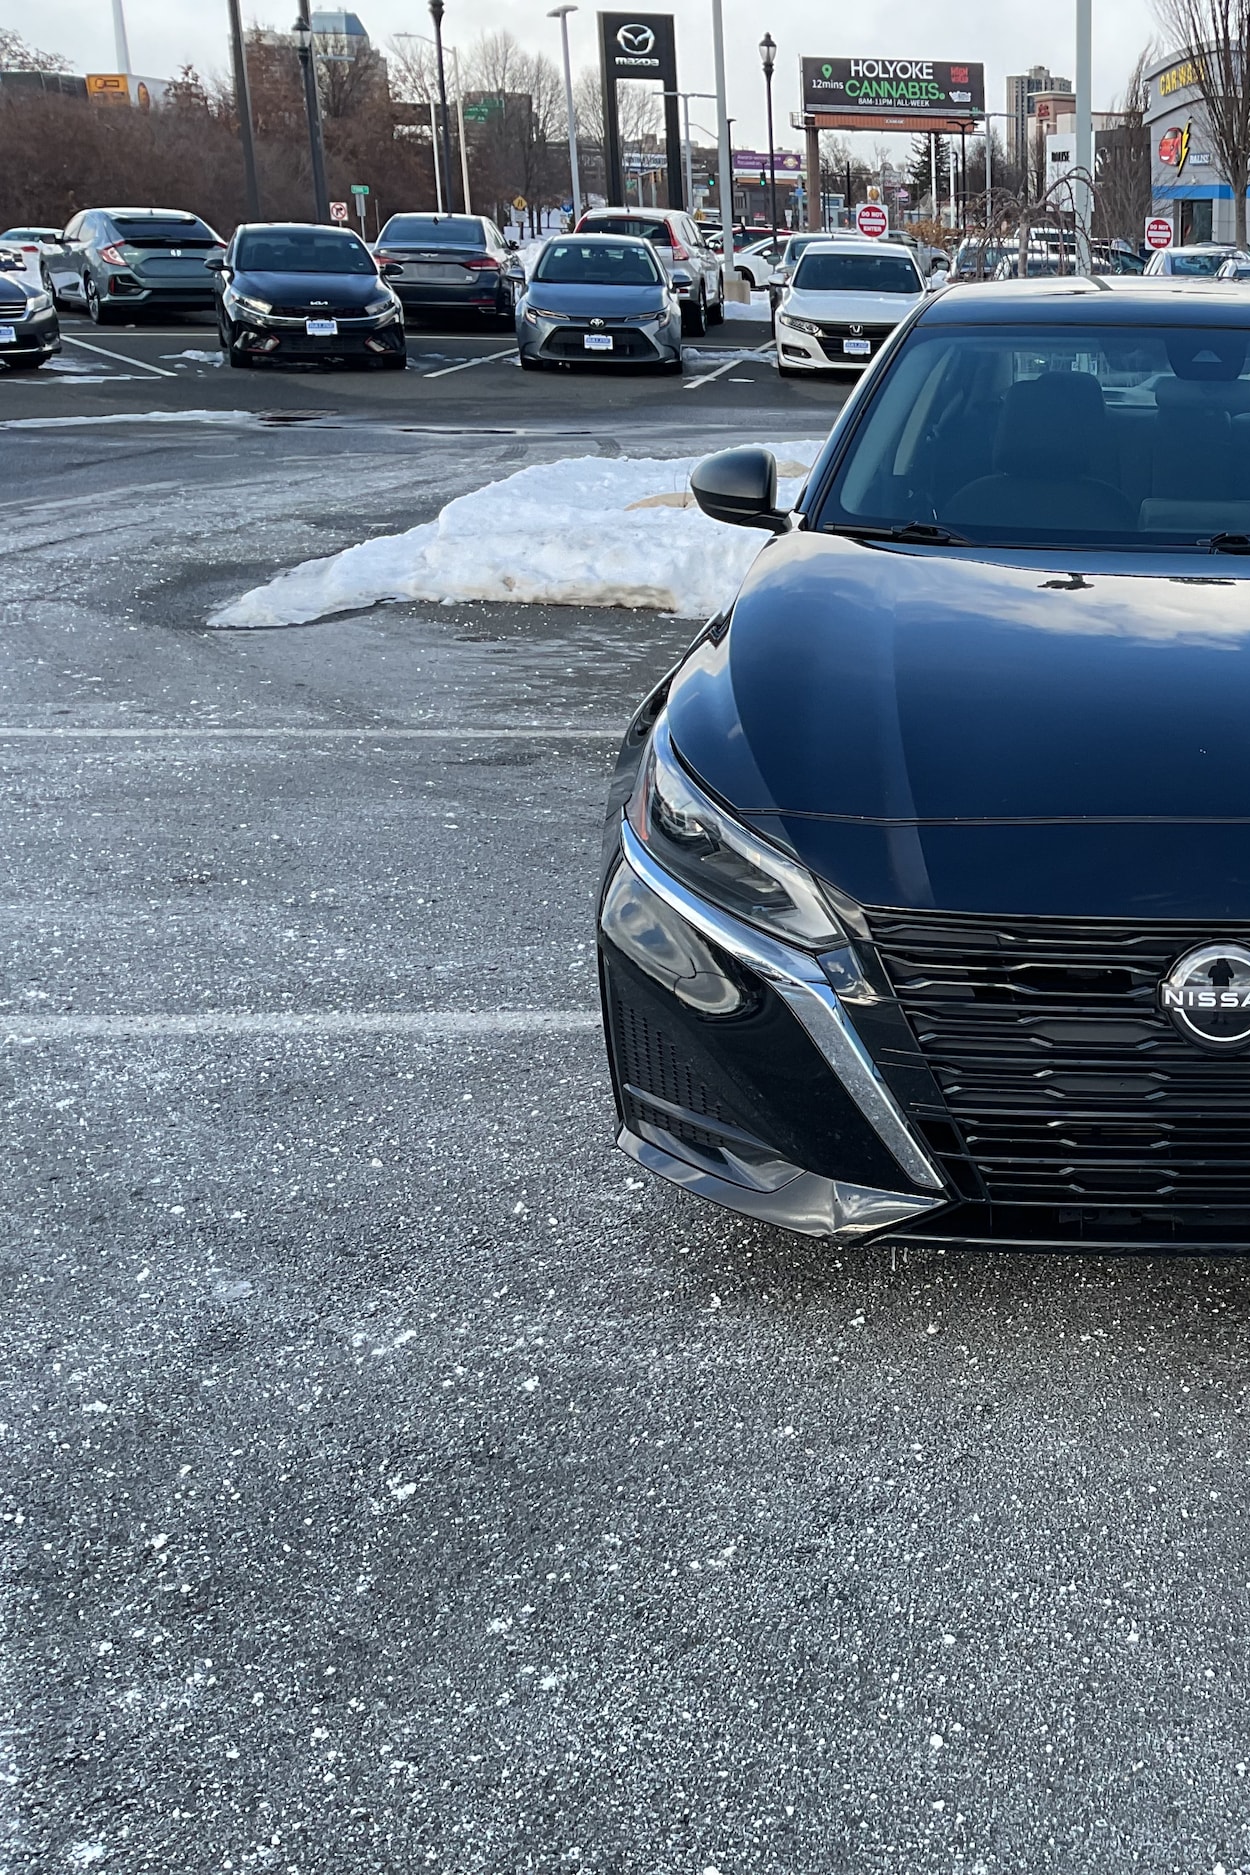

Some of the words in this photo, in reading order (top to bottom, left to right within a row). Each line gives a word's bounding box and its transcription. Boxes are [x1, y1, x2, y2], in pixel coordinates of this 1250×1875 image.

[615, 57, 660, 67] mazda
[850, 59, 934, 80] HOLYOKE
[811, 78, 844, 90] 12mins
[1159, 69, 1177, 97] CAR
[858, 97, 893, 106] 8AM-11PM
[861, 210, 870, 218] DO
